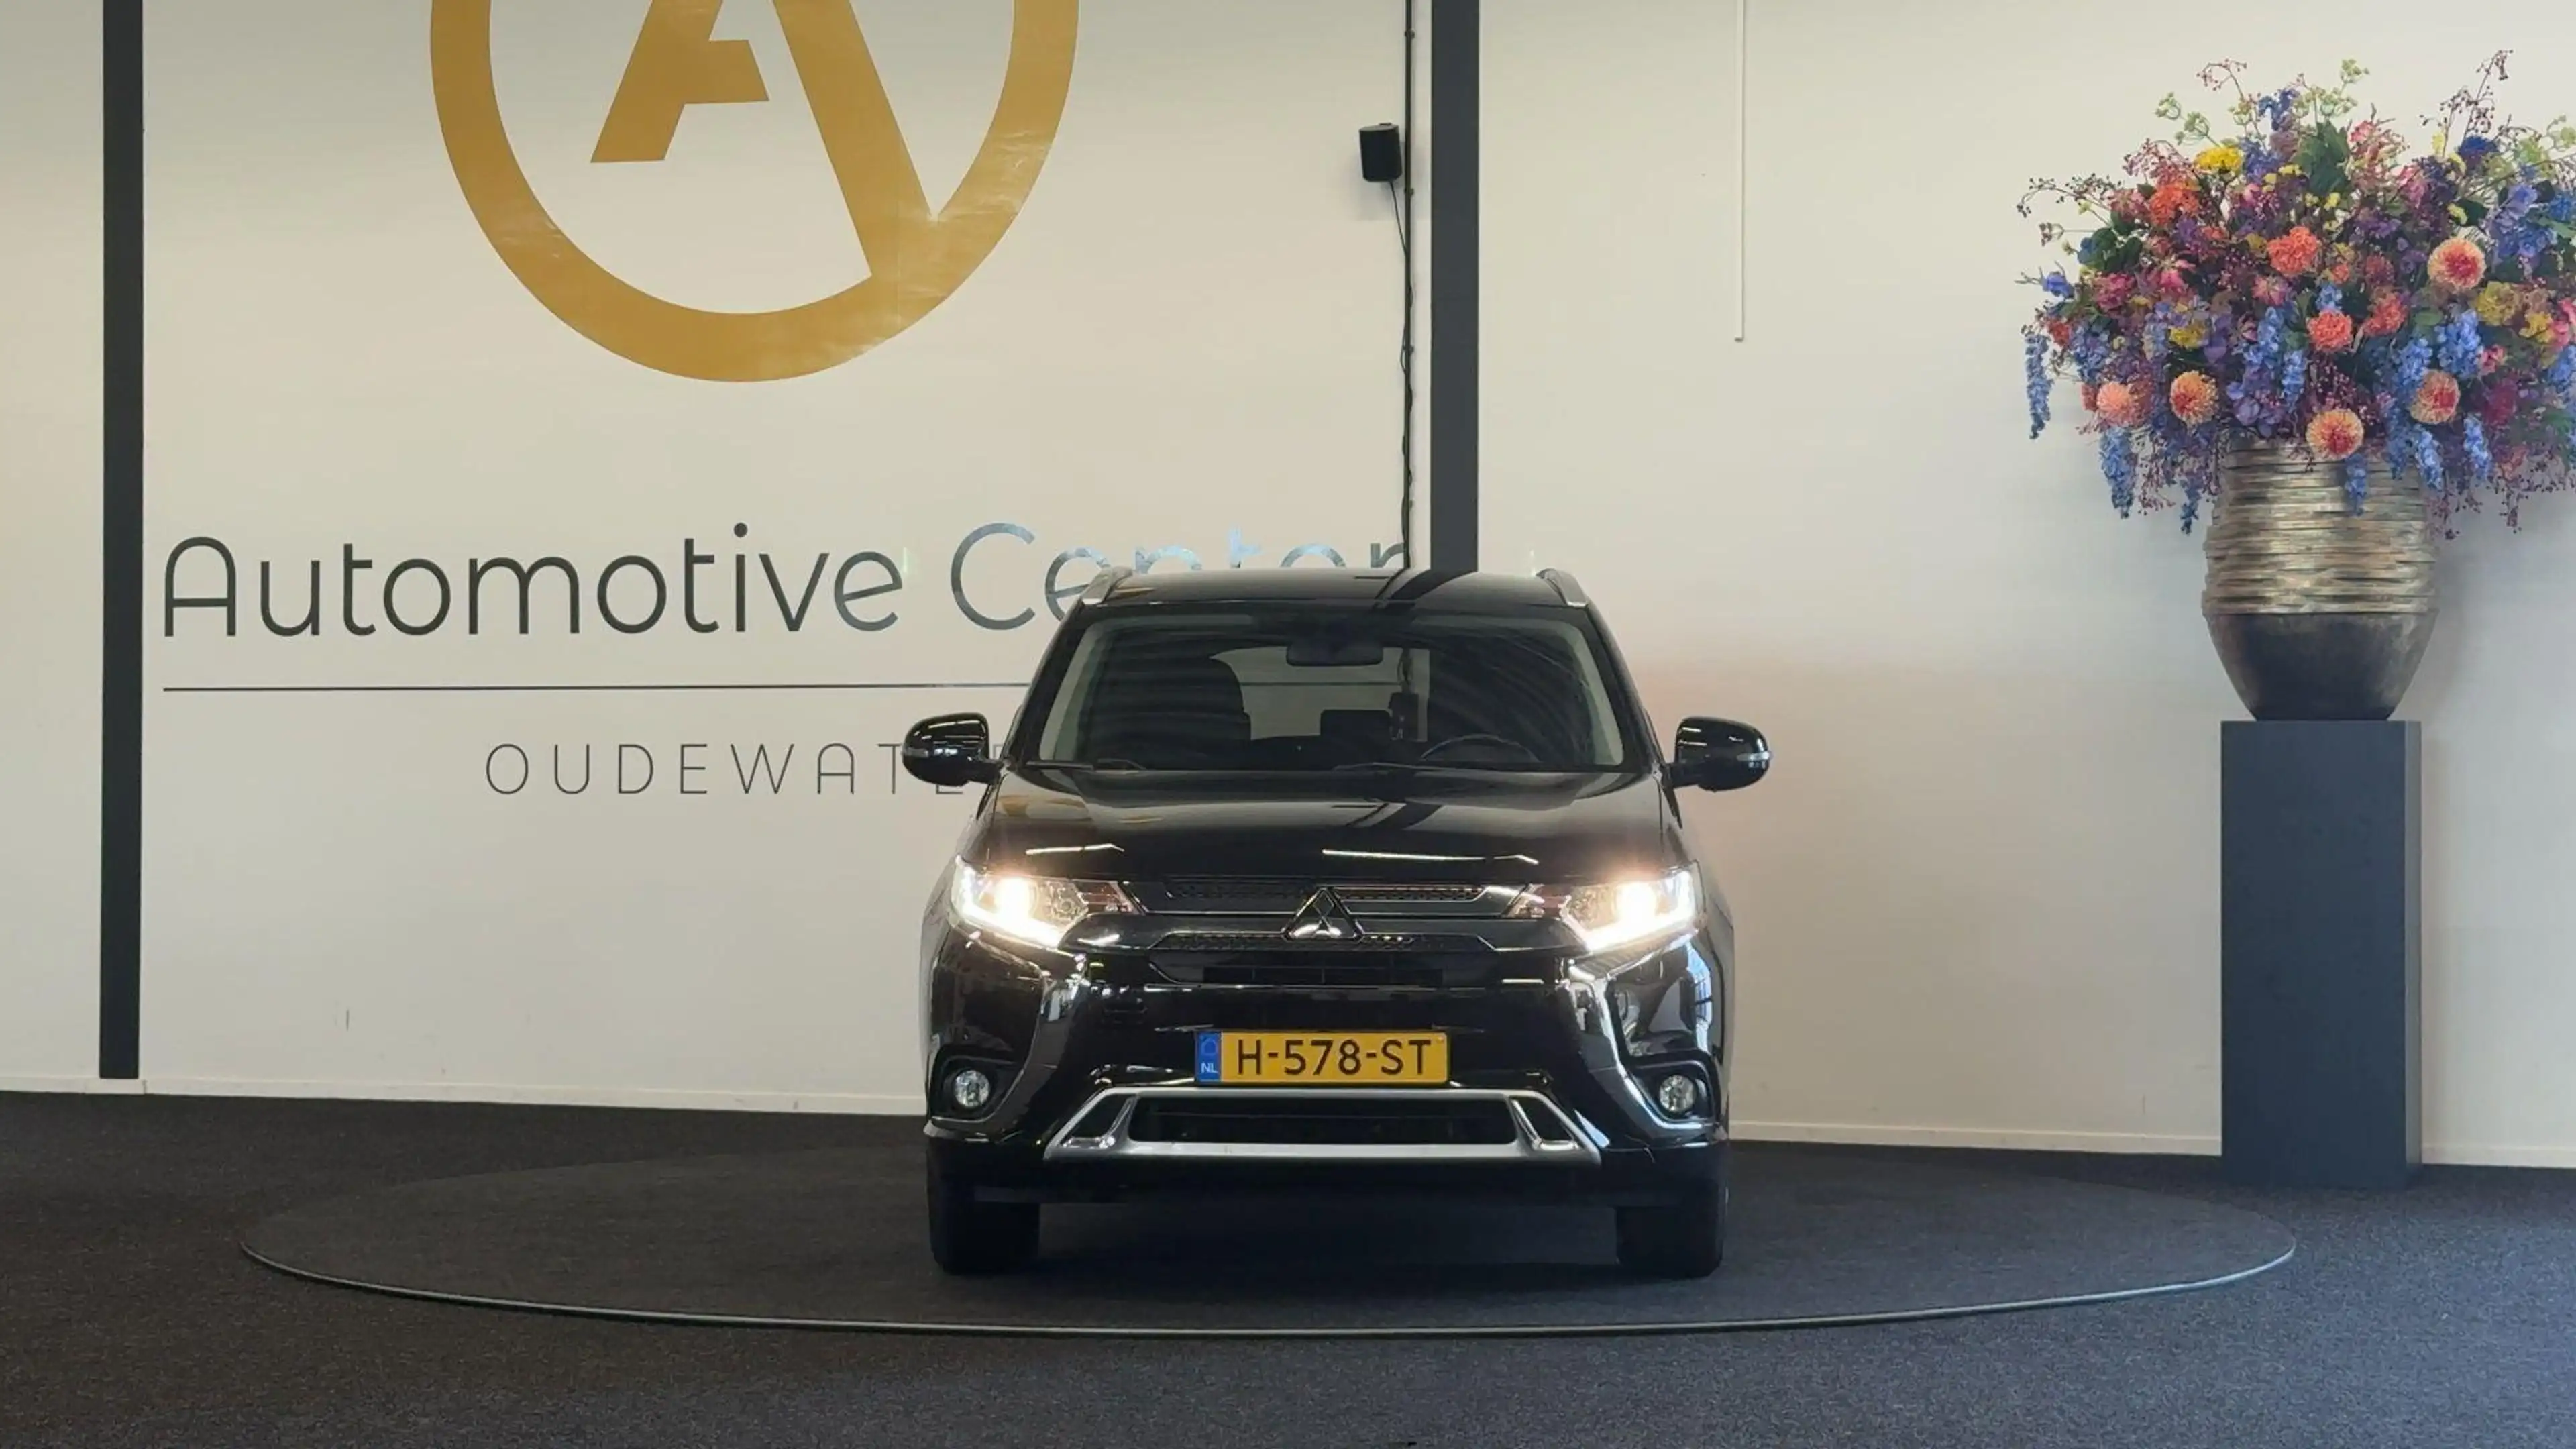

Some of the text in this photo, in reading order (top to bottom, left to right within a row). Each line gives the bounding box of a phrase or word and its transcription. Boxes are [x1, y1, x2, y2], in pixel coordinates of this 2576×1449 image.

[164, 521, 903, 637] Automotive
[486, 743, 1004, 795] OUDEWAT
[1201, 1039, 1431, 1075] NL H-578-ST
